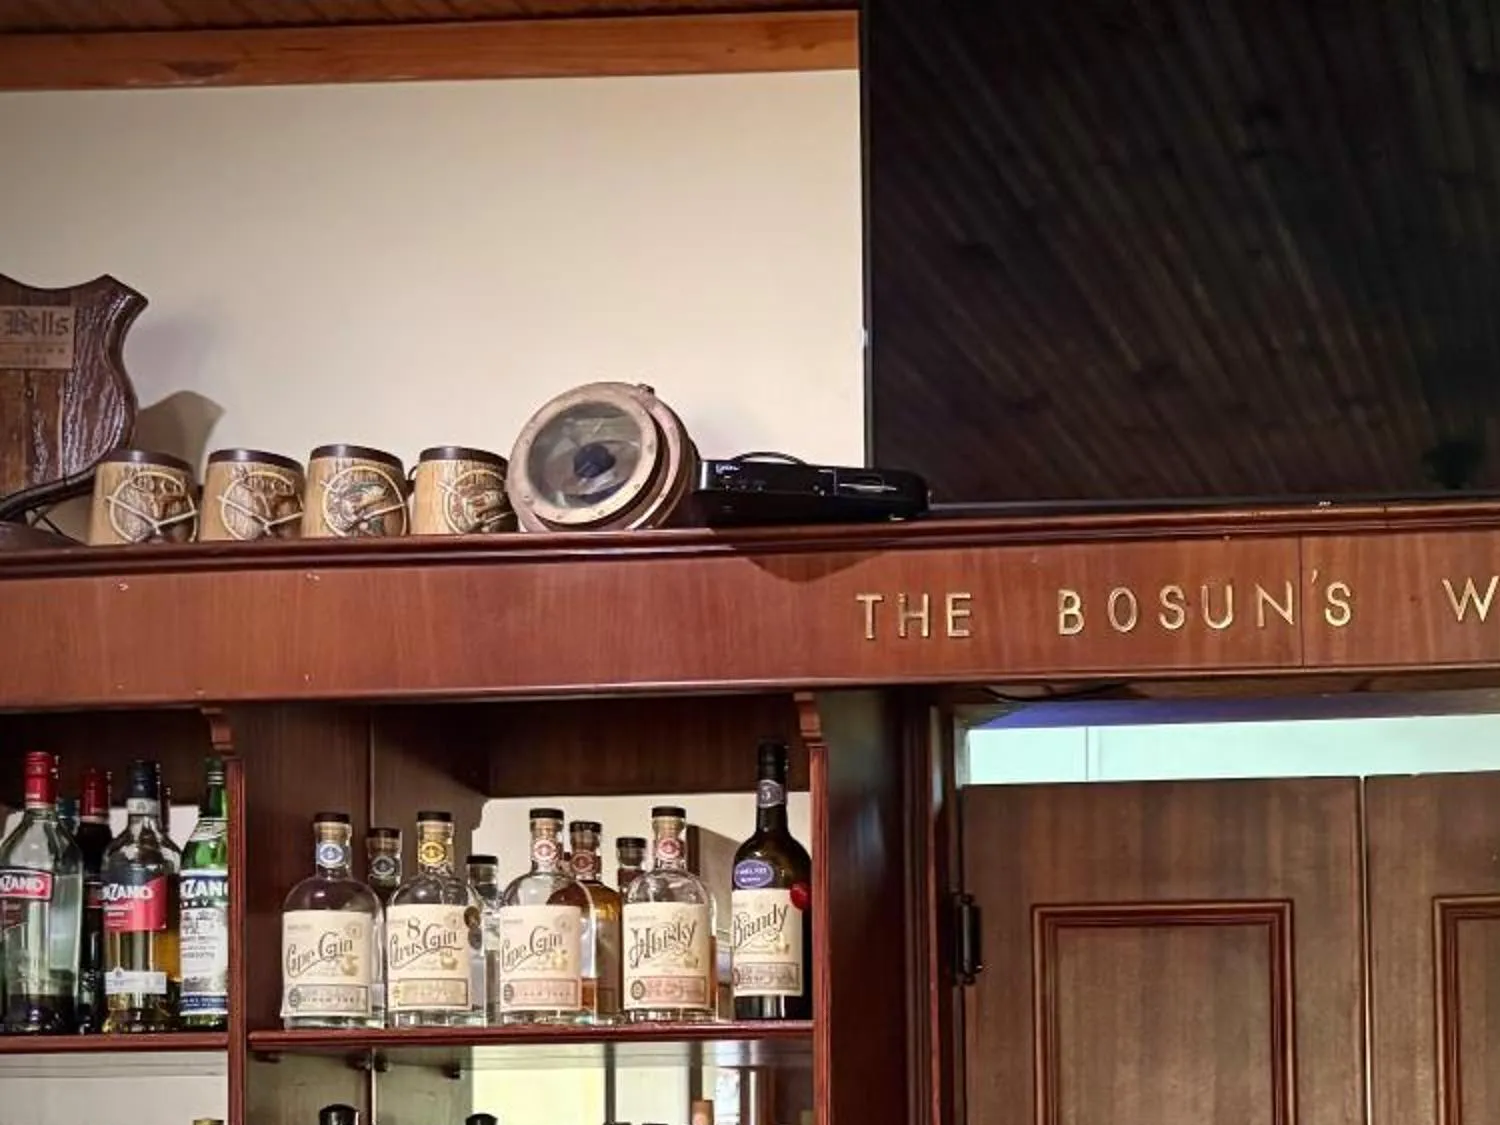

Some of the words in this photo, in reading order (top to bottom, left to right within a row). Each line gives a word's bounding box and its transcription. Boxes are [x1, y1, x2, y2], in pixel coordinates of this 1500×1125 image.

[856, 592, 972, 640] THE
[1057, 570, 1353, 636] BOSUN'S
[318, 931, 353, 961] Gin
[422, 923, 457, 950] Gin
[529, 925, 563, 957] Gin
